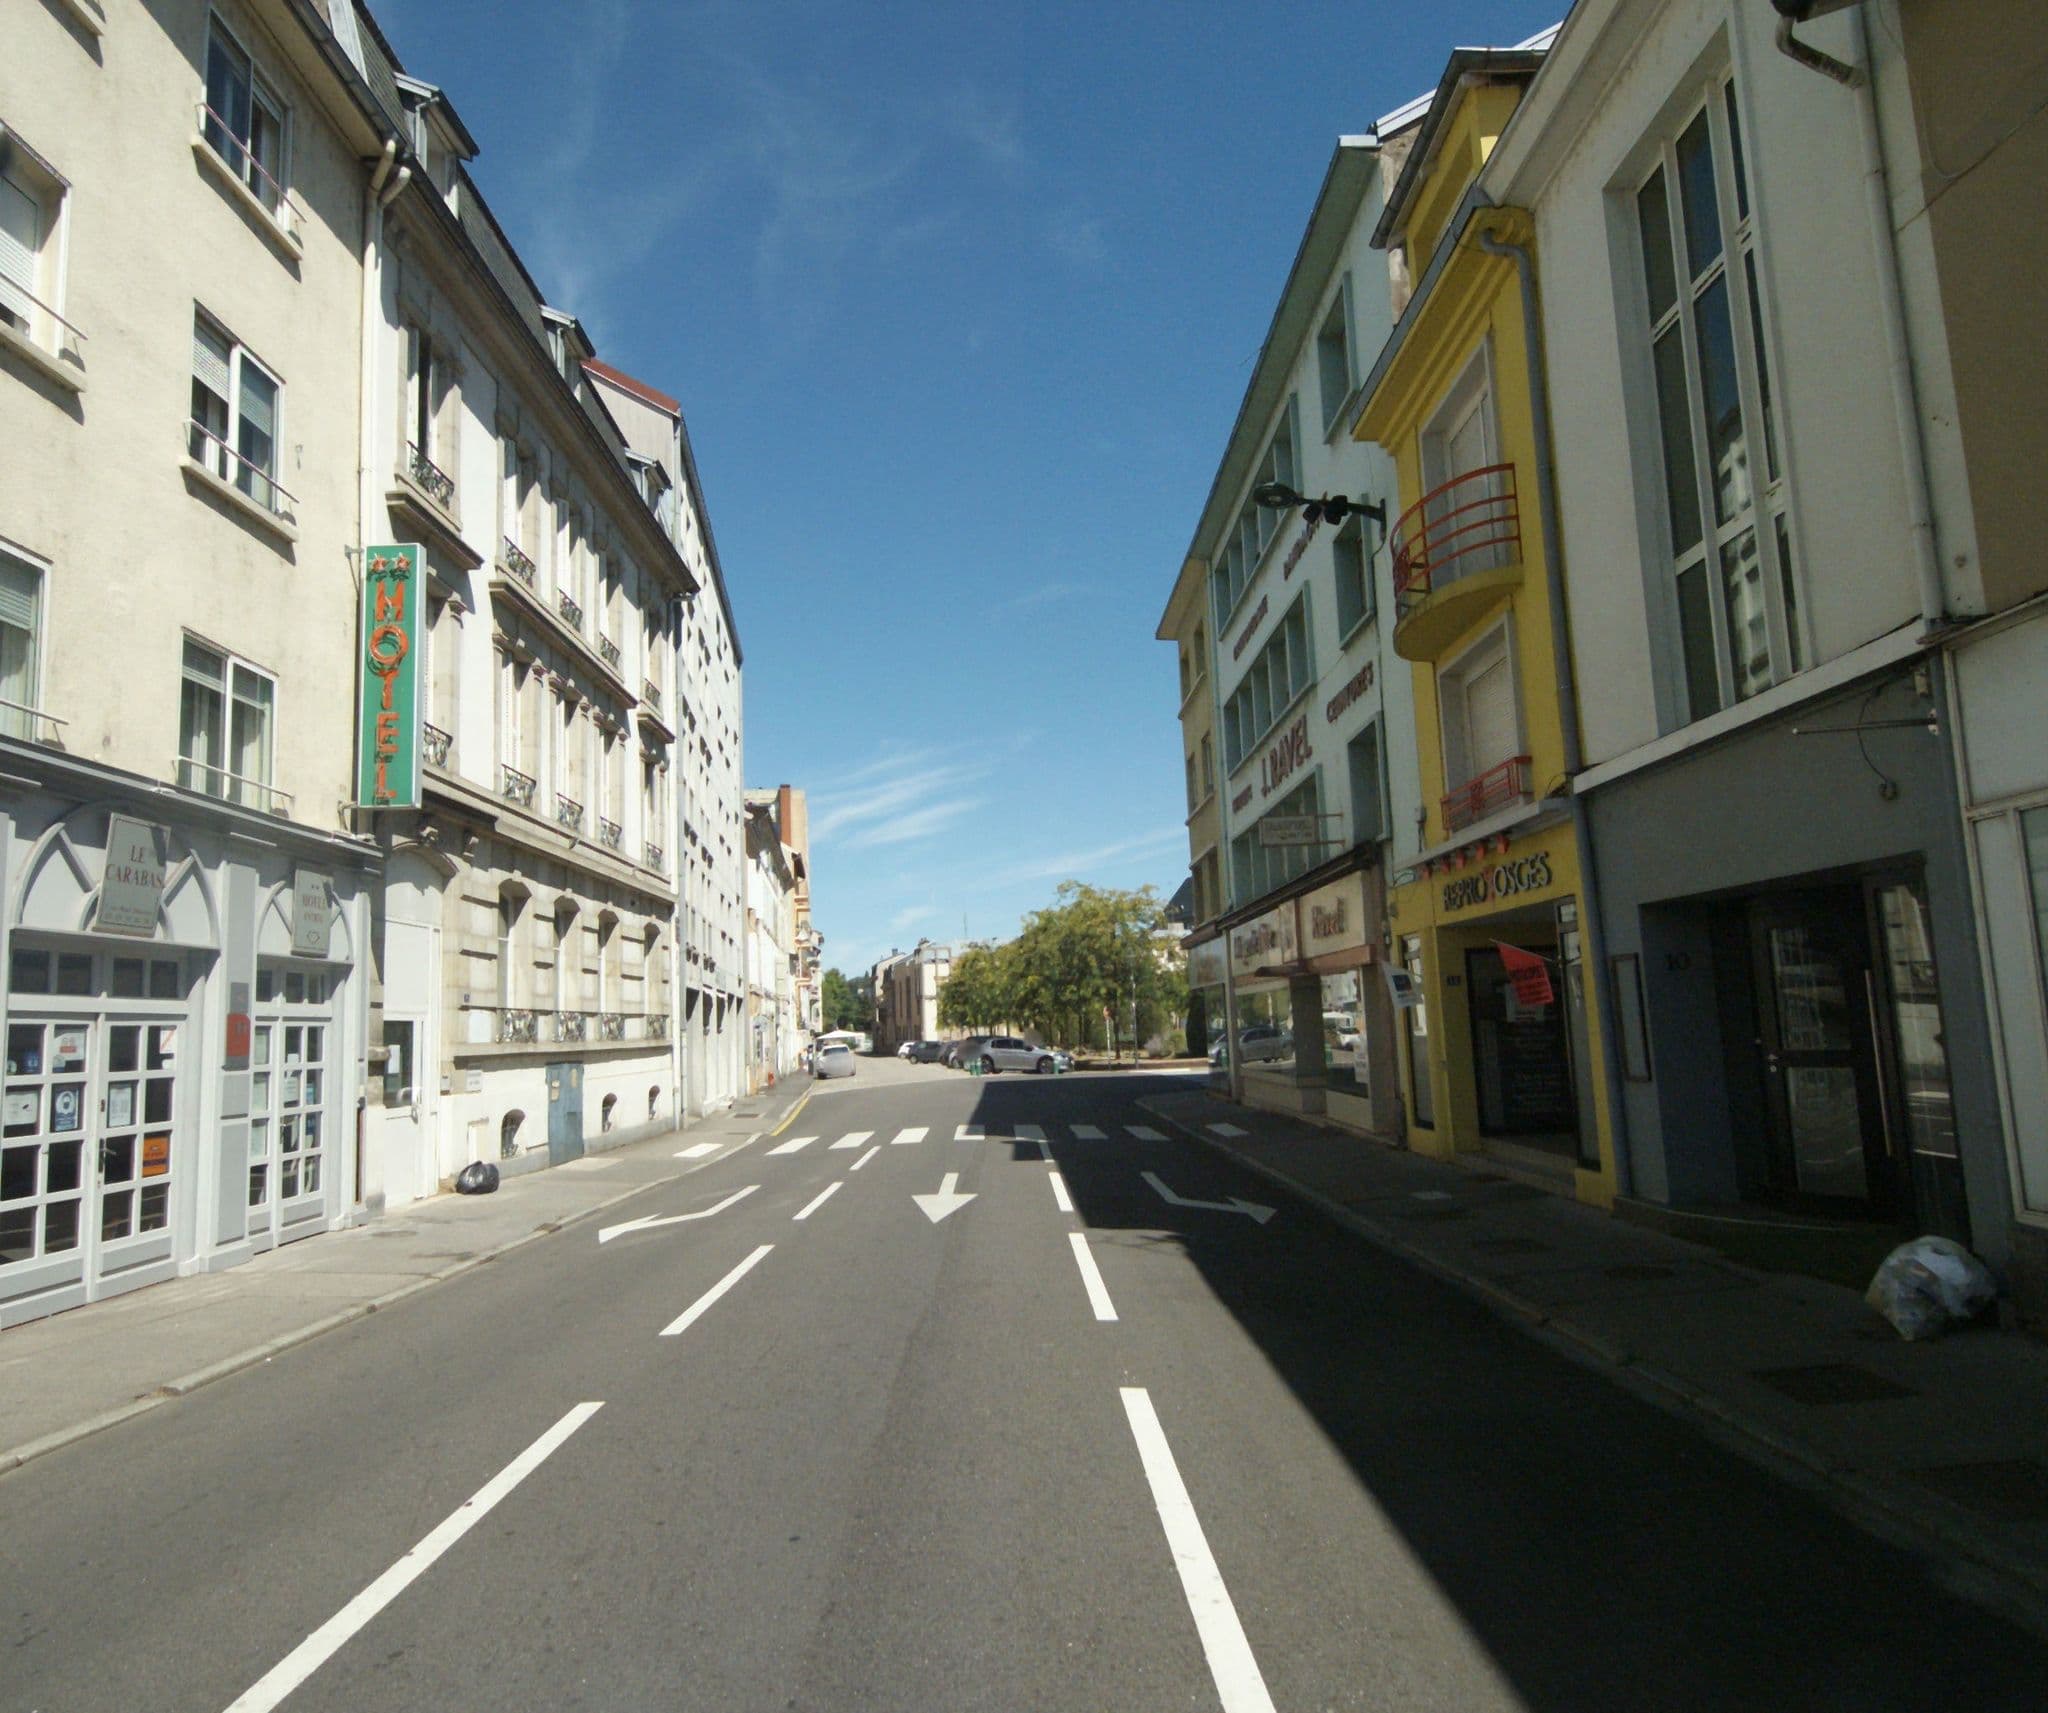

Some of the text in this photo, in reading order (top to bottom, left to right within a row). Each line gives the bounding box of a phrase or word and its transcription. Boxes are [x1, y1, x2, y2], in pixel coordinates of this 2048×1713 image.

[368, 581, 408, 799] HOTEL
[130, 844, 146, 864] LE
[105, 863, 165, 889] CARABAS
